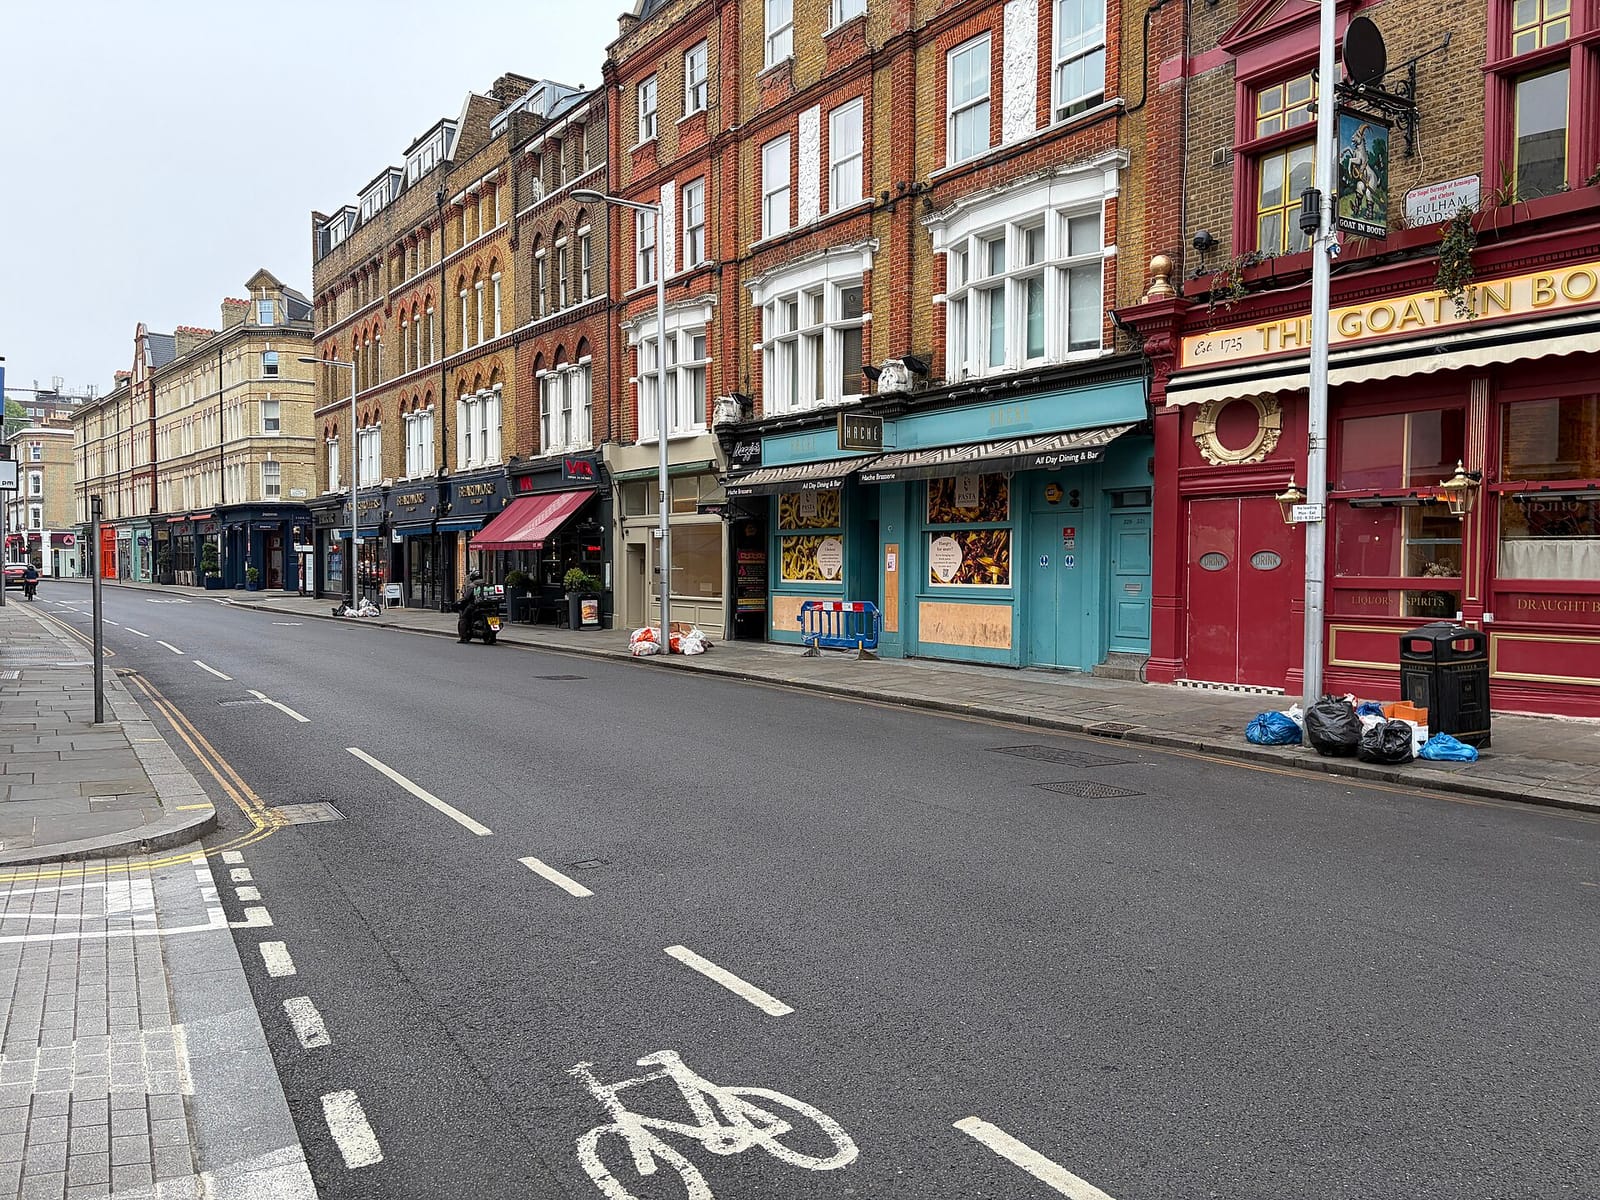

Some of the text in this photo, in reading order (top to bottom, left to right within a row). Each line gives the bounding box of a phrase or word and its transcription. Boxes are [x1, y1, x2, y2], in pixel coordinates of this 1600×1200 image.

[1430, 185, 1447, 194] Borough
[1453, 177, 1478, 187] Kensington
[1437, 191, 1455, 199] Chelsea
[1416, 194, 1468, 216] FULHAM
[1339, 218, 1386, 237] GOAT IN BOOTS
[1408, 212, 1443, 228] ROAD
[1337, 291, 1448, 338] GOAT
[1465, 280, 1512, 317] IN
[1220, 336, 1243, 353] 1725
[1035, 451, 1099, 465] All Day Dining & Bar
[816, 481, 829, 489] Dining
[1255, 554, 1278, 567] DRINK
[1351, 595, 1445, 607] LIQUORS SPIRITS
[1518, 599, 1590, 612] DRAUGHT
